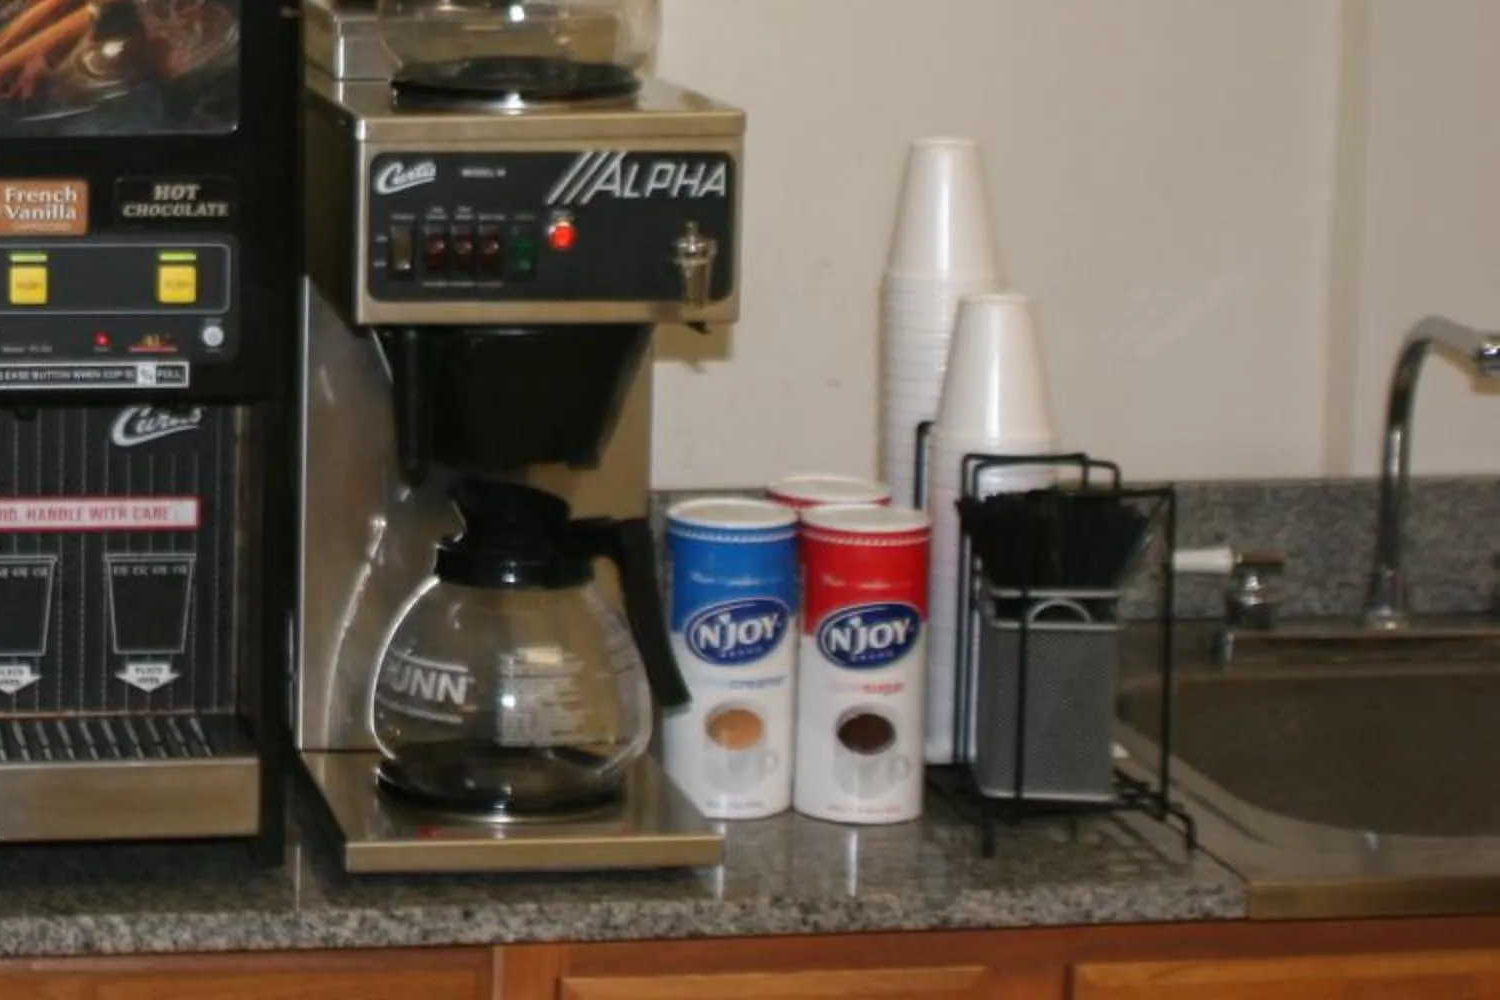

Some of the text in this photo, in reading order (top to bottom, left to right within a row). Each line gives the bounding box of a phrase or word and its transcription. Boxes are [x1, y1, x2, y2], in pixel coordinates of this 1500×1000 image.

[5, 185, 77, 203] French
[153, 184, 200, 201] HOT
[5, 203, 77, 221] Vanilla
[122, 203, 229, 218] CHOCOLATE
[27, 506, 82, 521] HANDLE
[89, 506, 127, 521] WITH
